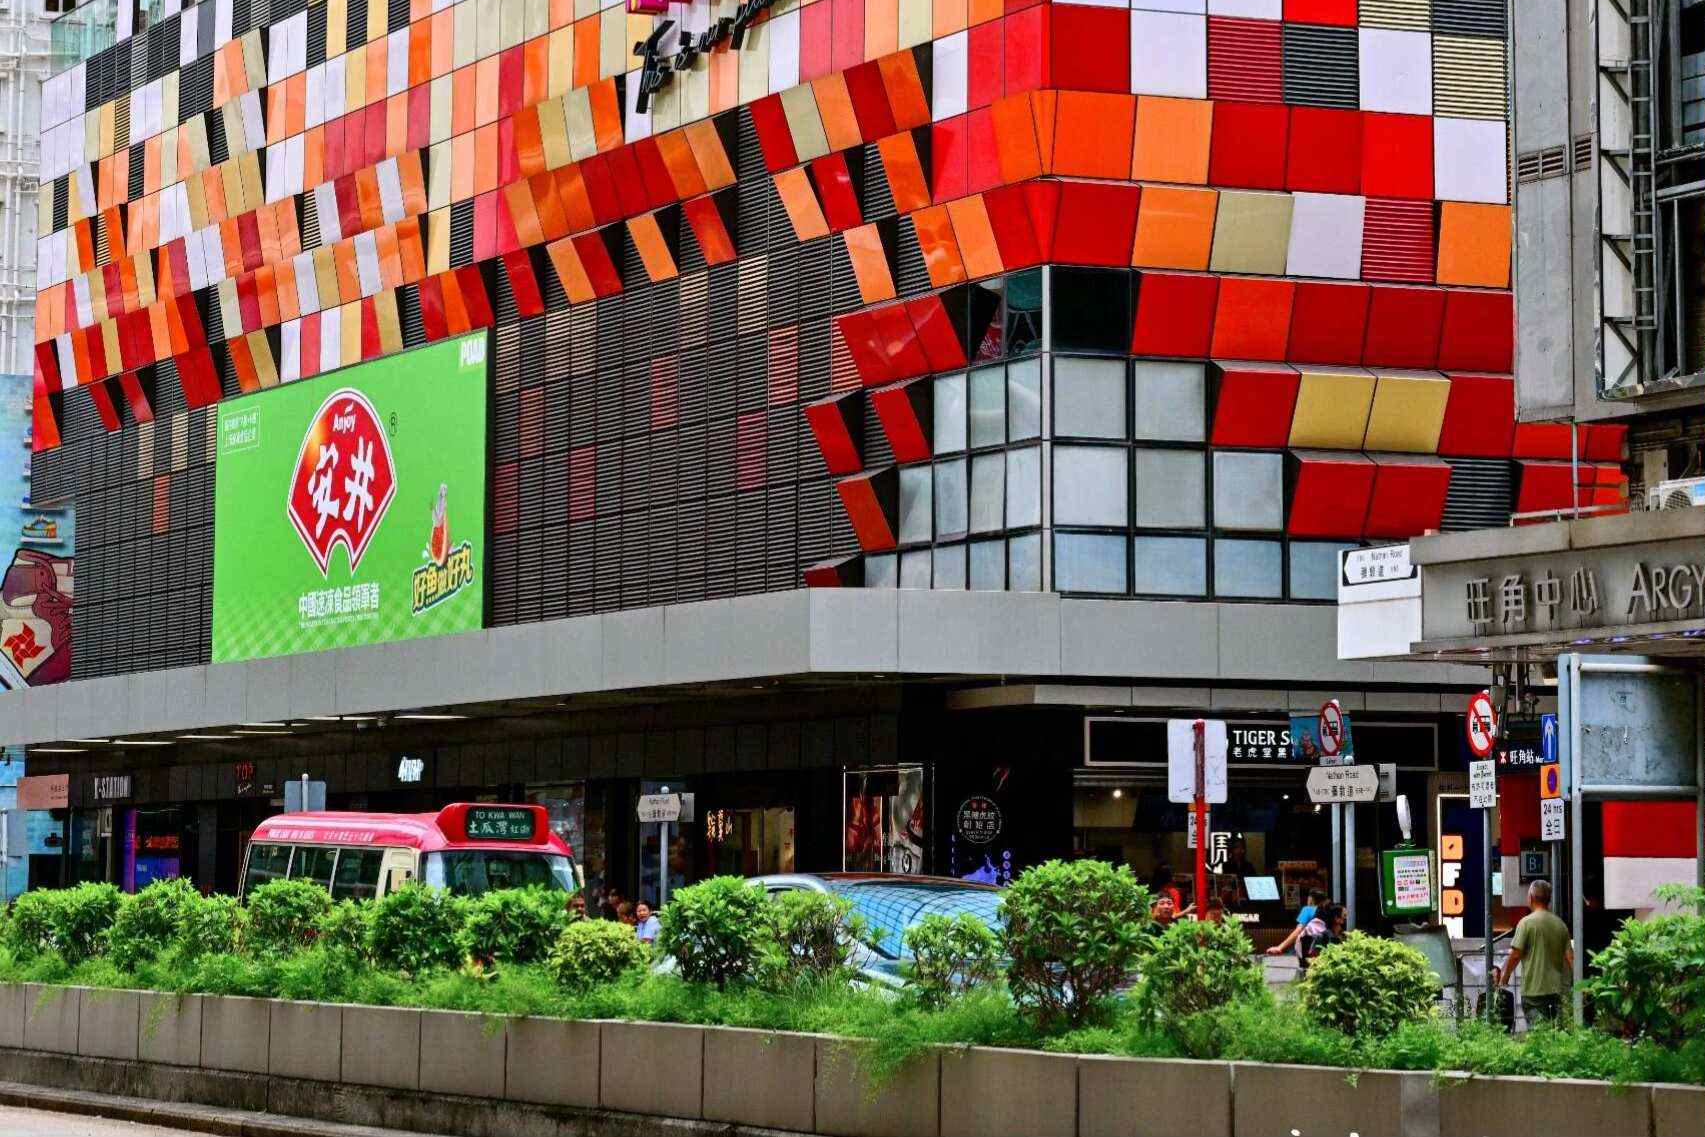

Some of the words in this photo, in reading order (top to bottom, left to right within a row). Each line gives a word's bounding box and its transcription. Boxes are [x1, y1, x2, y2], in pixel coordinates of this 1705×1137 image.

[332, 412, 357, 436] Anjoy
[1465, 566, 1601, 626] 旺角中心
[1232, 730, 1277, 746] TIGER
[1509, 749, 1534, 765] 旺角站
[1543, 804, 1552, 815] 24
